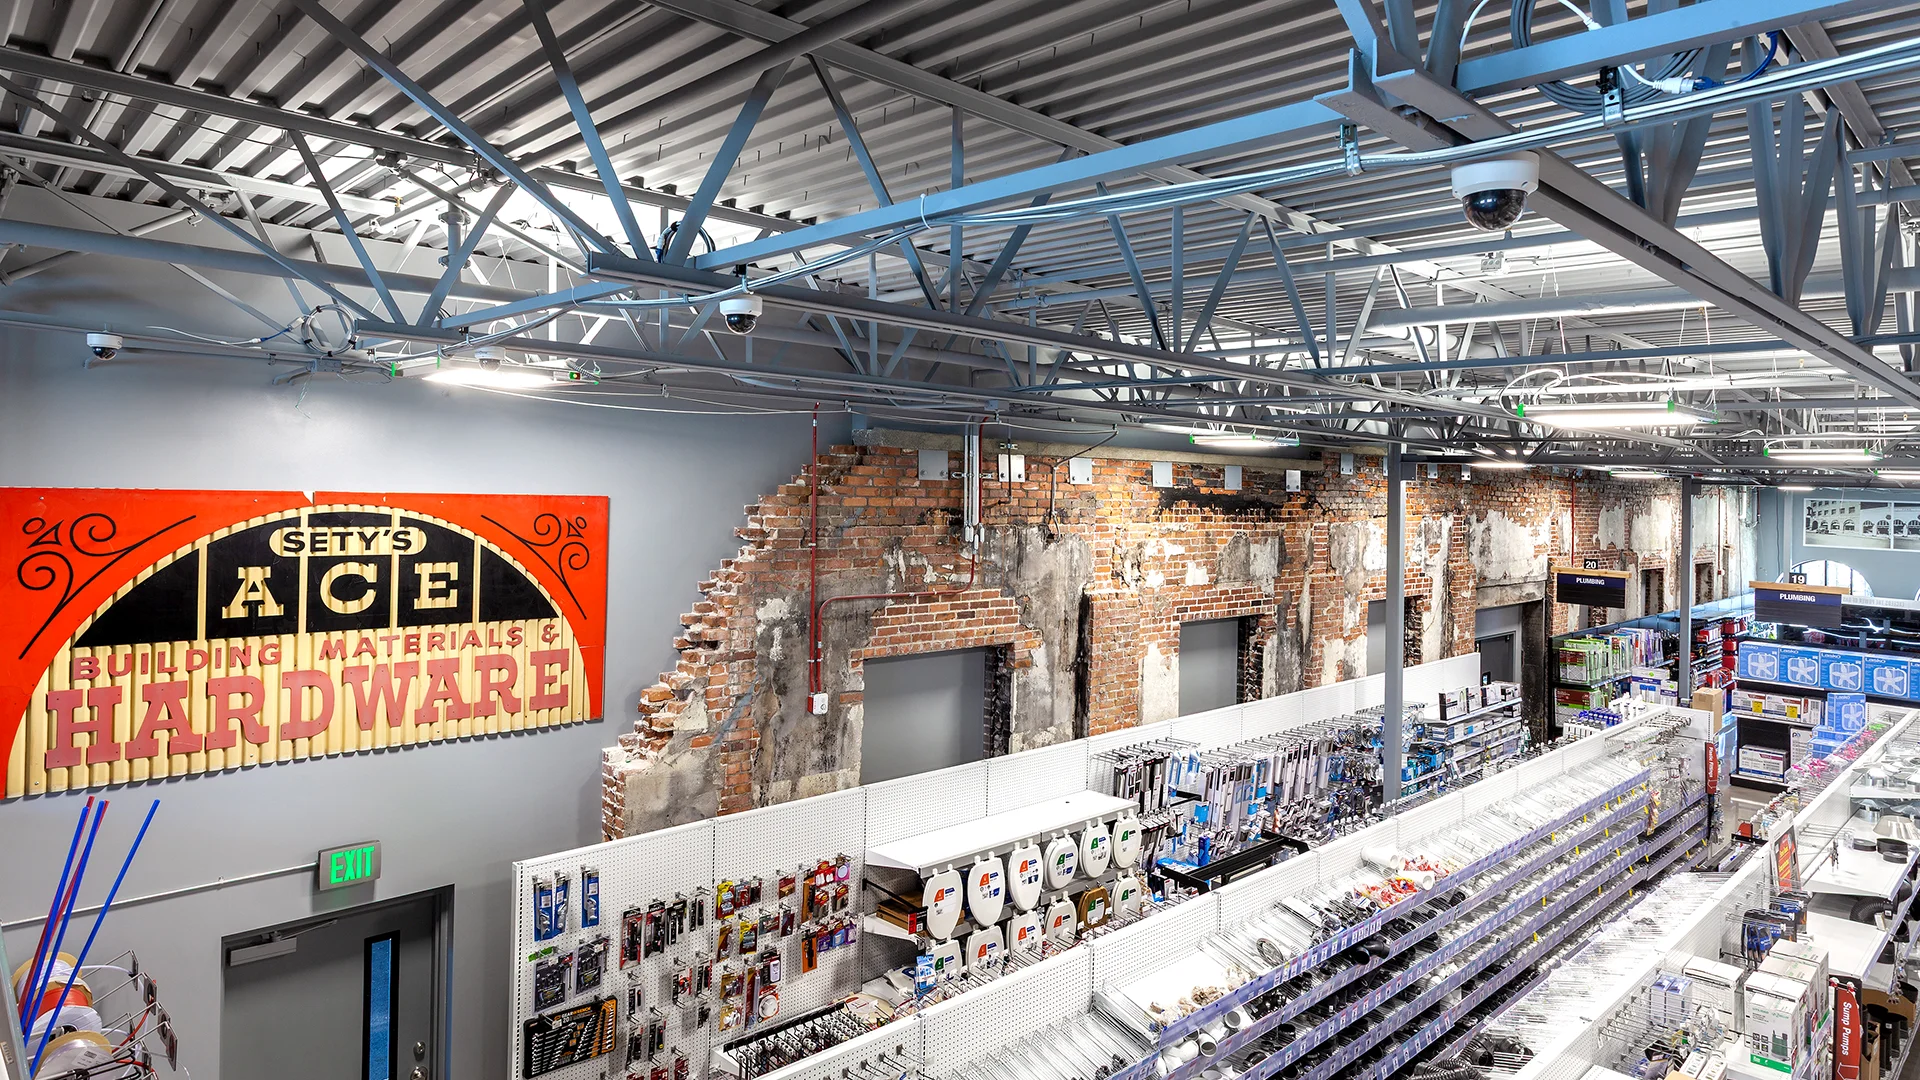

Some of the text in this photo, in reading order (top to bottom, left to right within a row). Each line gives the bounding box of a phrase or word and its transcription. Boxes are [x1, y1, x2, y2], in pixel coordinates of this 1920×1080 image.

[282, 525, 414, 554] SETY'S
[1576, 577, 1605, 586] PLUMBING
[1585, 560, 1597, 569] 20
[1791, 574, 1806, 584] 19
[221, 561, 460, 619] ACE
[1779, 593, 1816, 602] PLUMBING
[72, 623, 560, 681] BUILDING MATERIALS &
[45, 648, 570, 769] HARDWARE
[330, 845, 375, 884] EXIT
[1840, 1001, 1852, 1056] Sump Pumps
